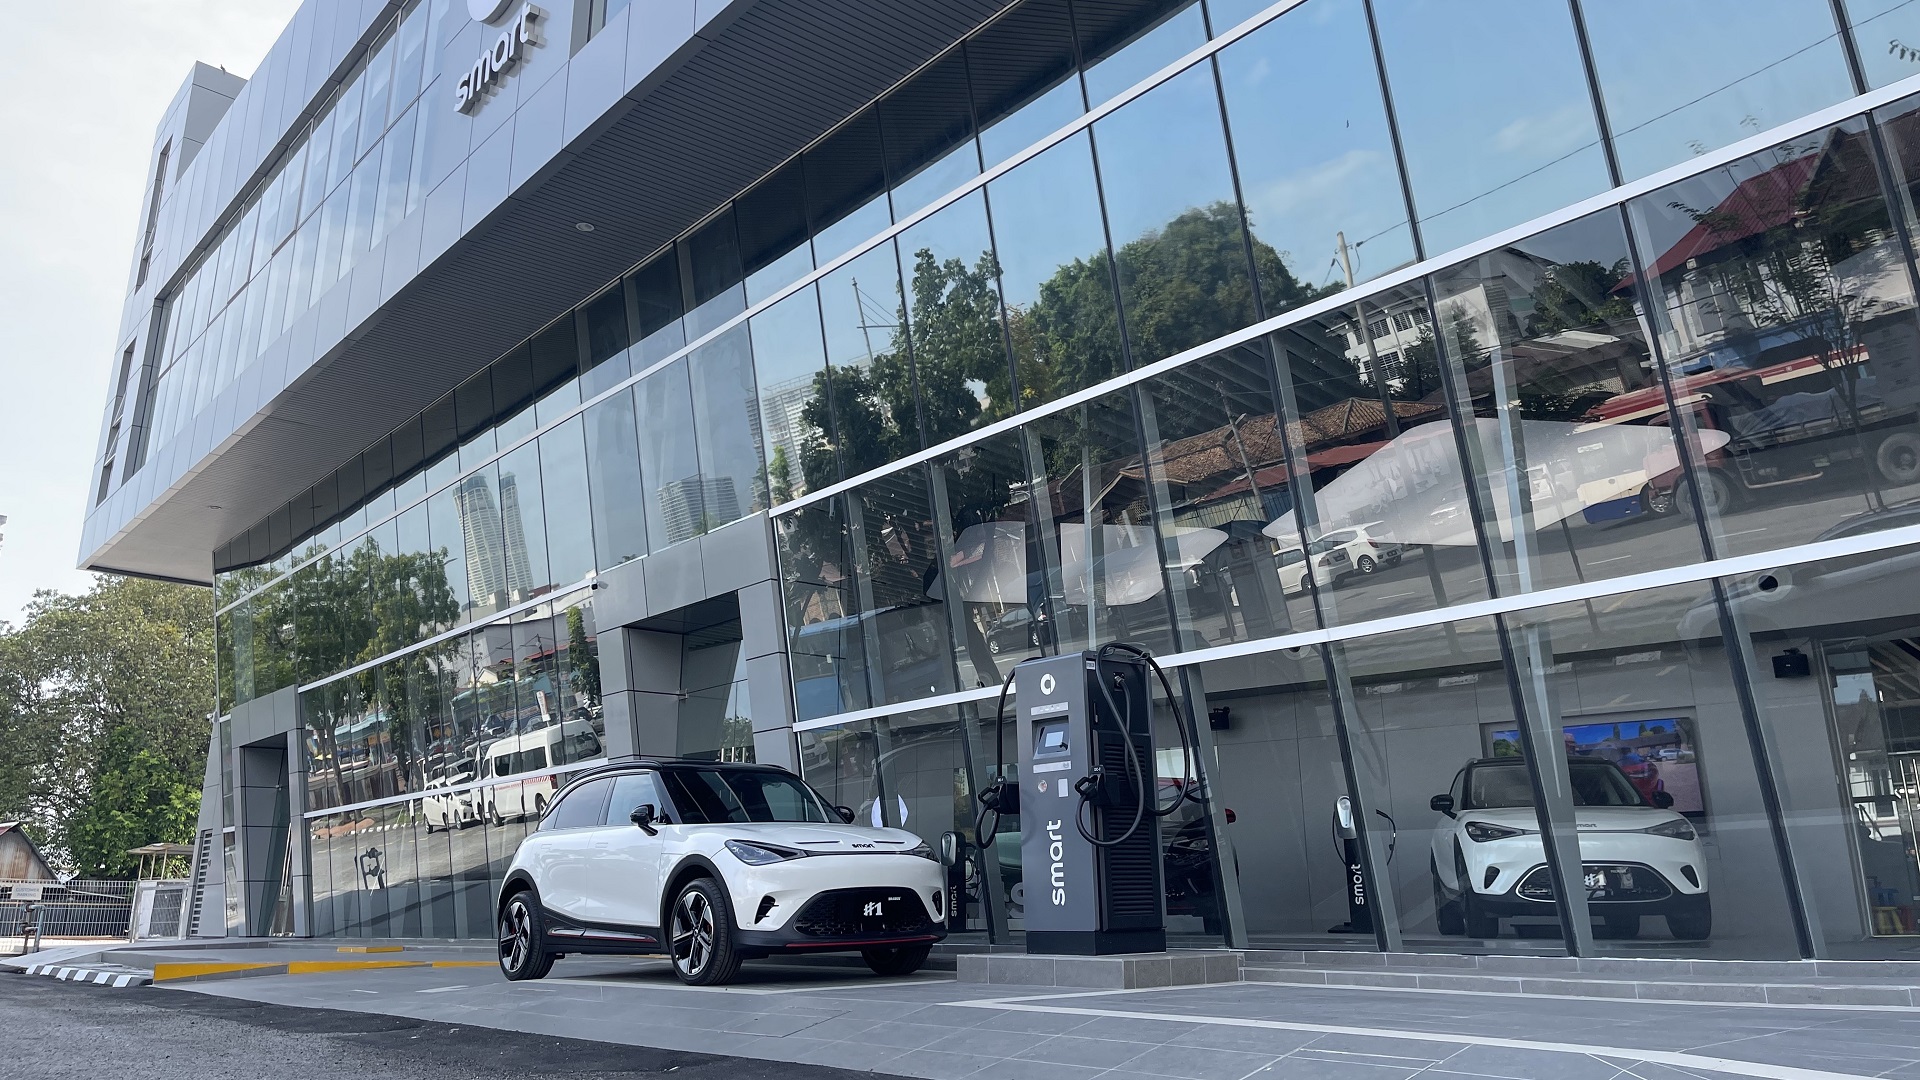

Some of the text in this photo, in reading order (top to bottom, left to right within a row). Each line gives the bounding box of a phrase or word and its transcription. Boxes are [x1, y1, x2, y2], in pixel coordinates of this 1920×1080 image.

[453, 2, 538, 114] smart
[1046, 819, 1066, 906] smart
[1584, 870, 1606, 887] #1
[1350, 863, 1365, 905] smart
[863, 901, 883, 916] #1
